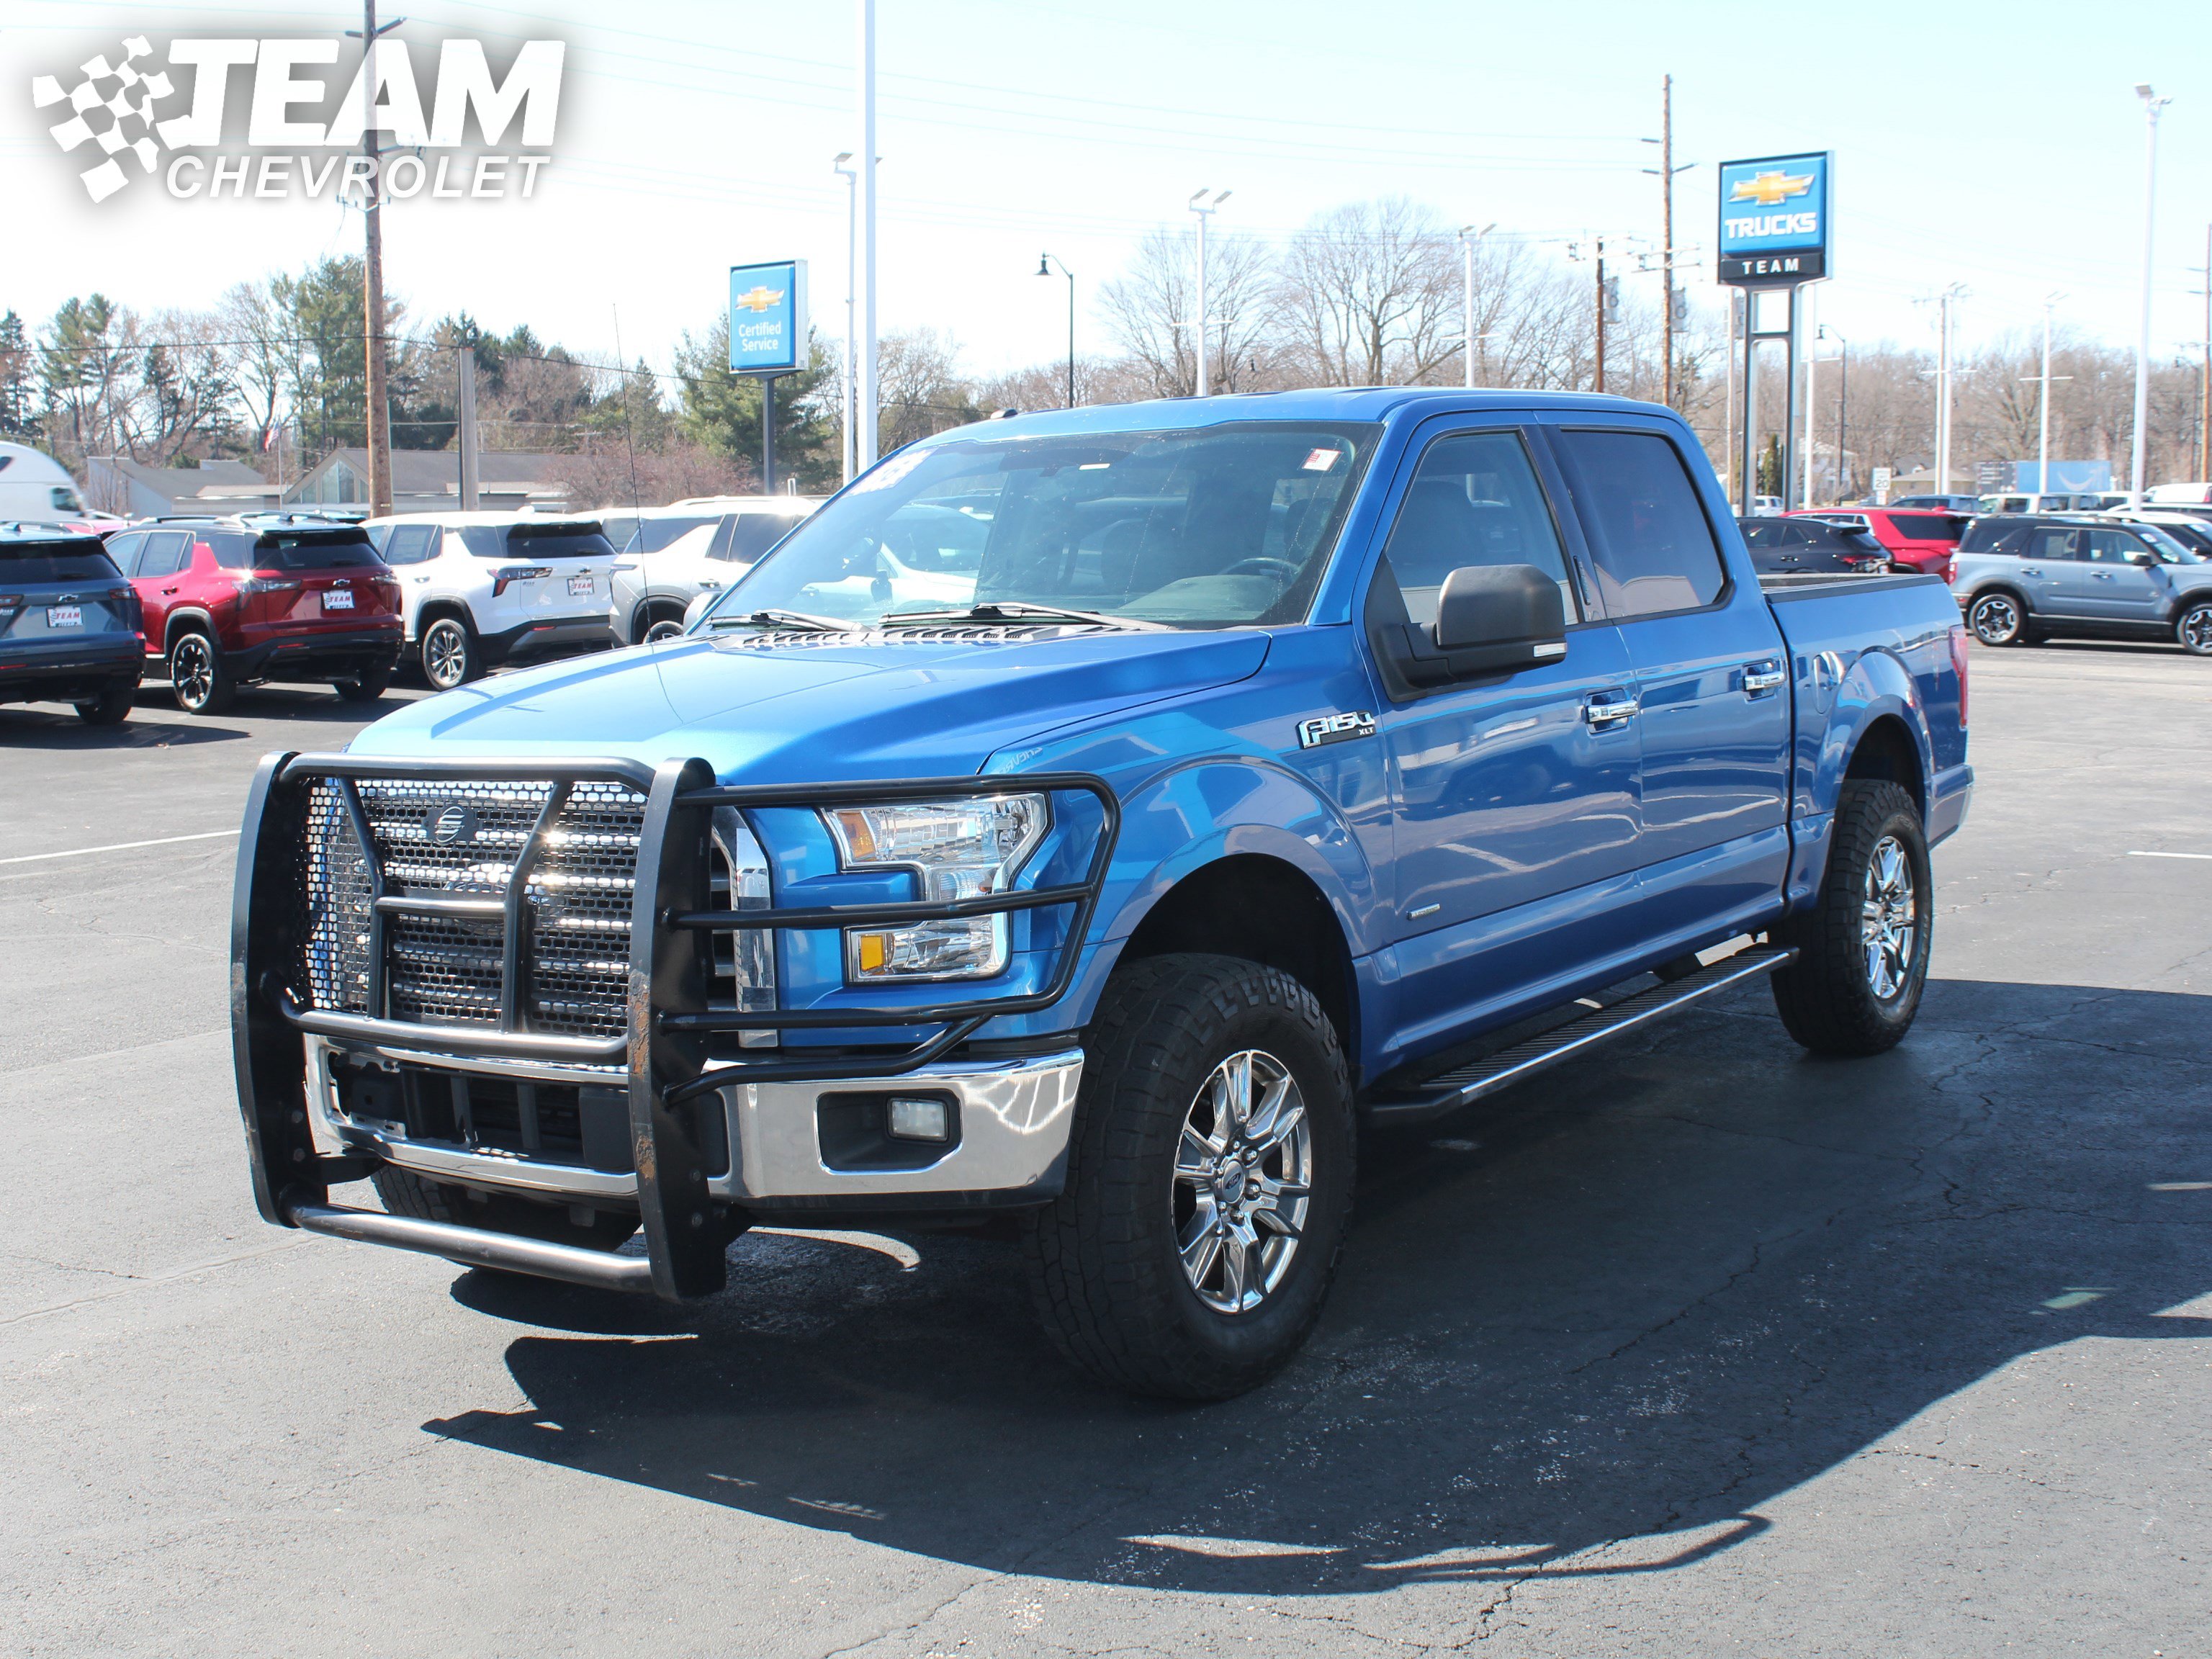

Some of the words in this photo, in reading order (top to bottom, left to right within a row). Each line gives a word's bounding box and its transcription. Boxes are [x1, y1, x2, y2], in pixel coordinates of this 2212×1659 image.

[1725, 212, 1817, 239] TRUCKS
[1742, 258, 1799, 275] TEAM
[738, 320, 782, 337] Certified
[742, 337, 779, 352] Service
[1875, 479, 1890, 488] 20
[1358, 727, 1374, 735] XLT
